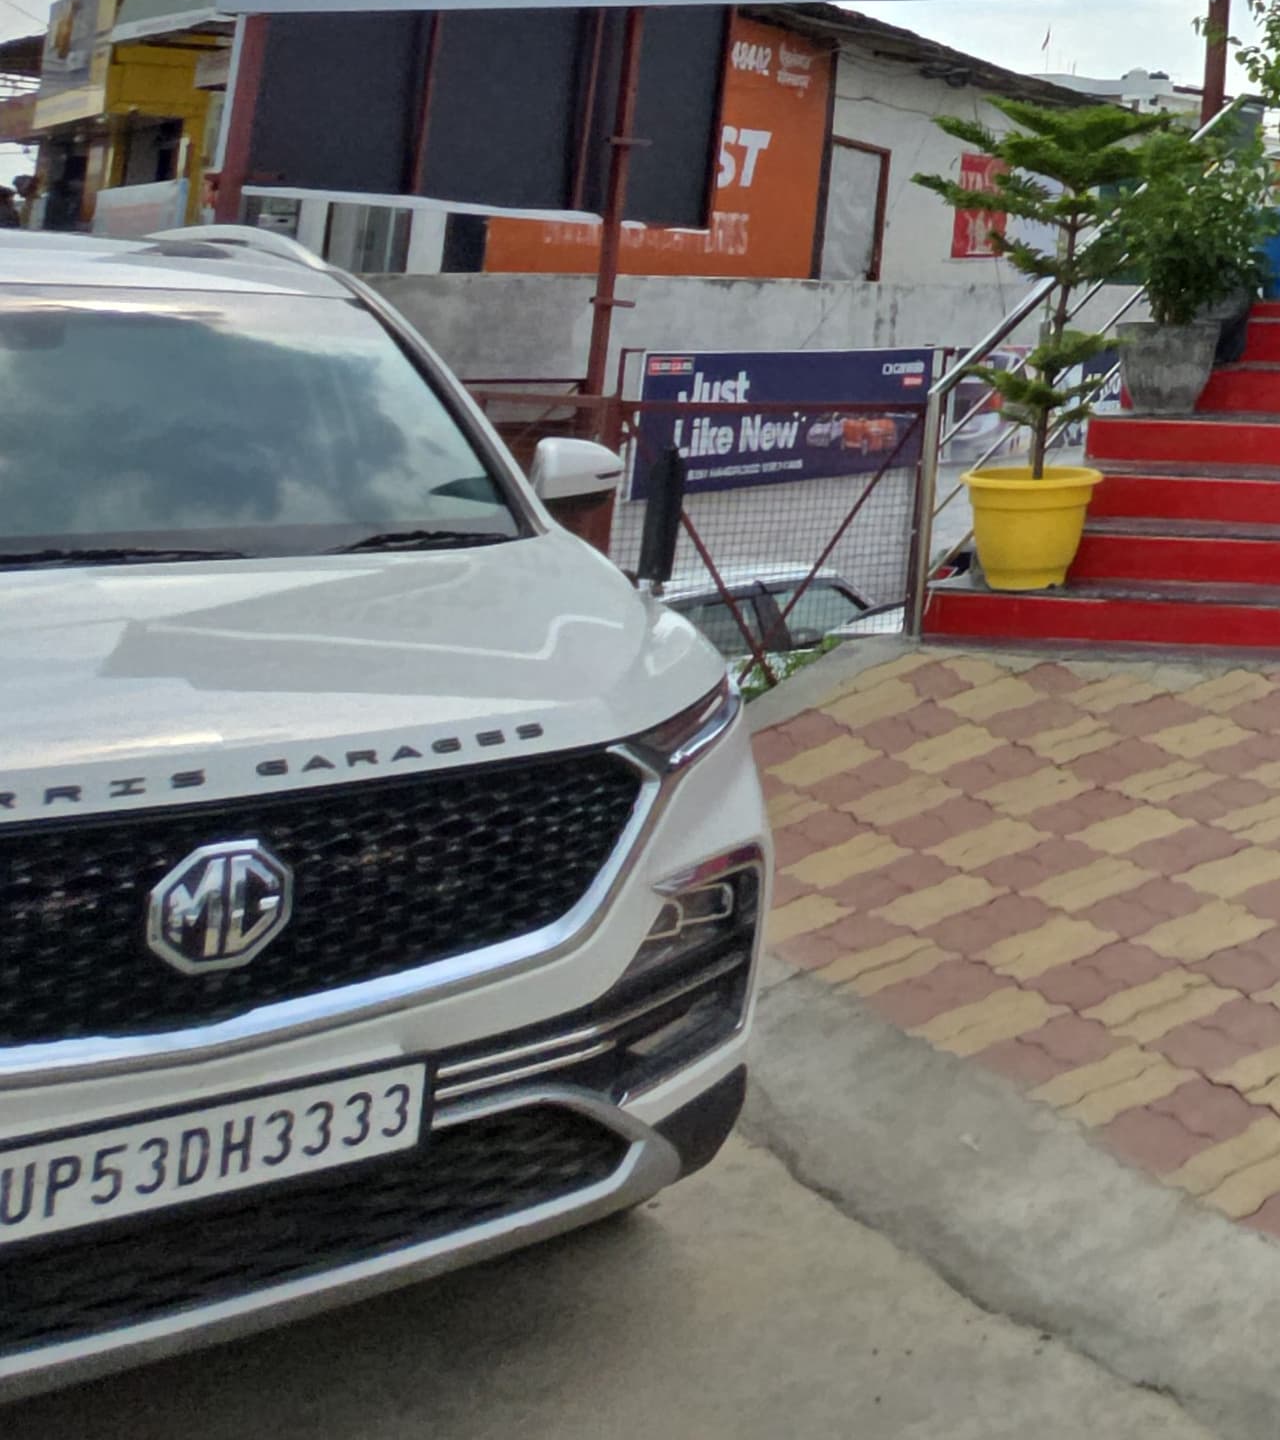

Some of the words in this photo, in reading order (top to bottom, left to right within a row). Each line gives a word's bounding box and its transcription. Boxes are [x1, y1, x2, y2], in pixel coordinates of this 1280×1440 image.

[678, 371, 750, 403] Just
[674, 416, 734, 458] Like
[738, 414, 800, 453] New
[255, 721, 545, 777] GARAGES
[162, 852, 287, 960] MG
[0, 1082, 411, 1227] UP53DH3333
